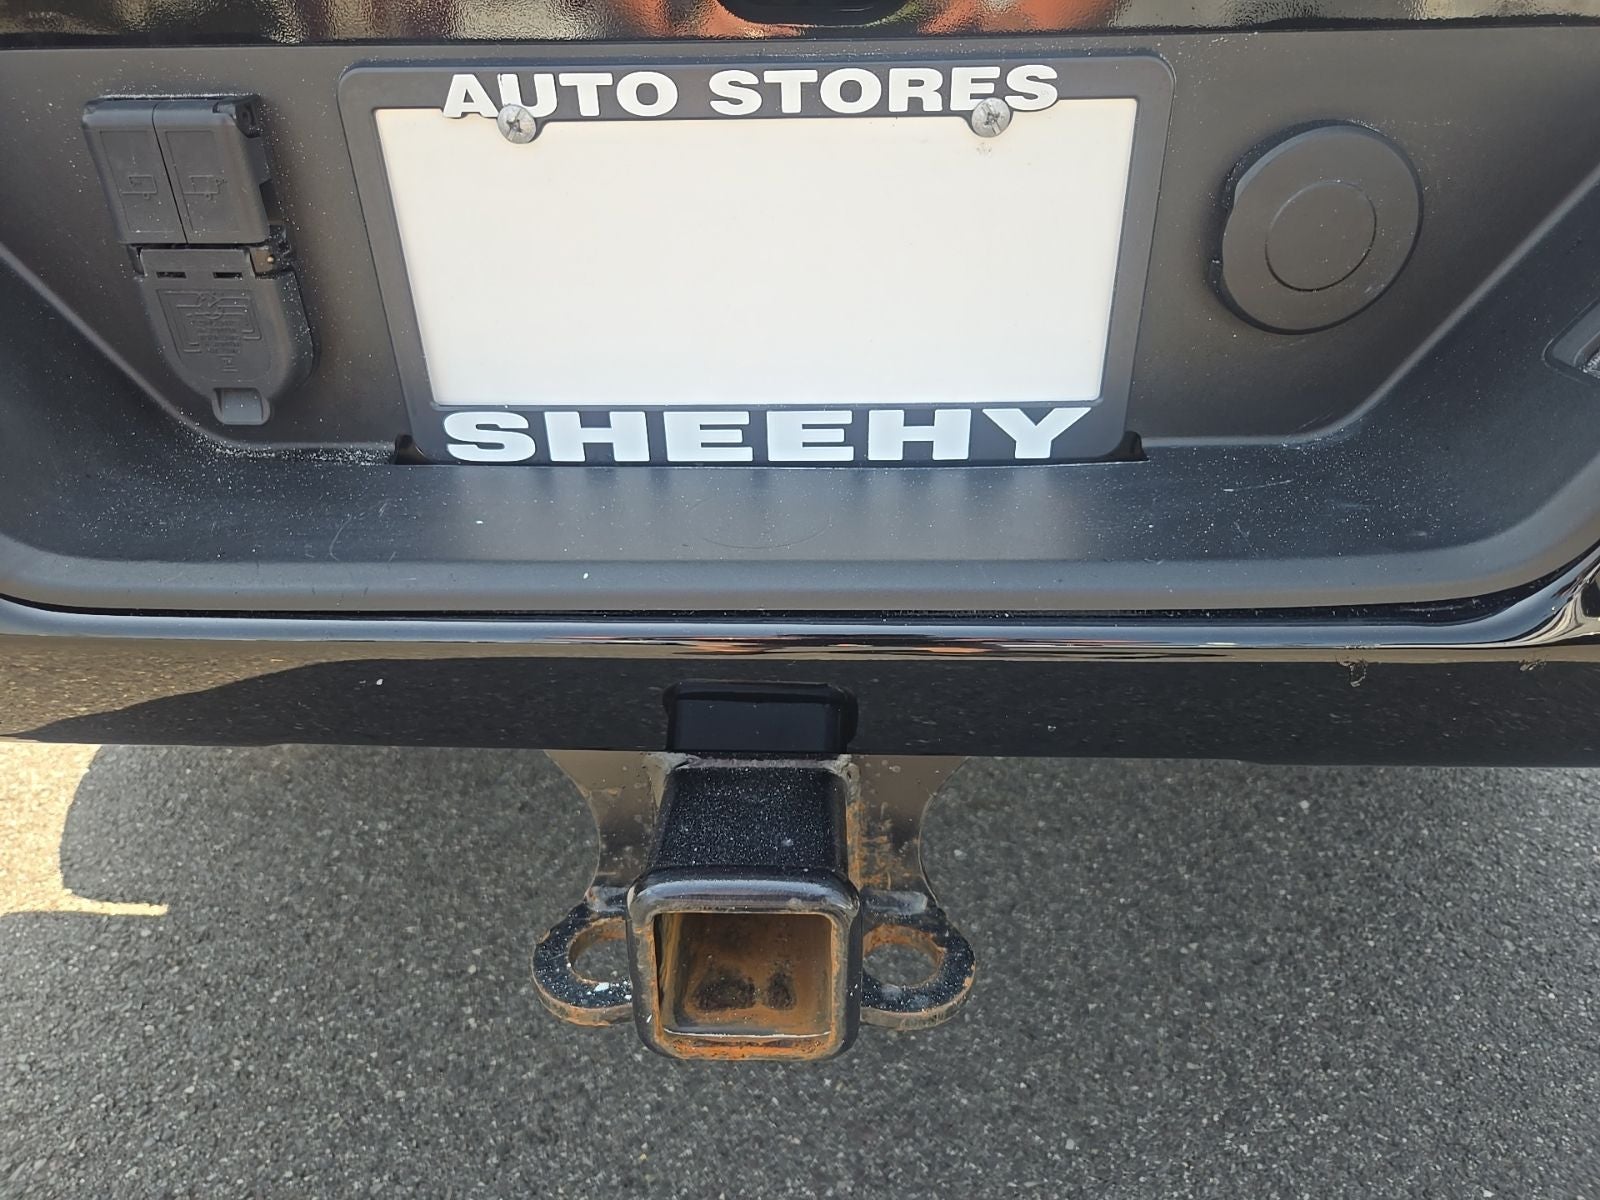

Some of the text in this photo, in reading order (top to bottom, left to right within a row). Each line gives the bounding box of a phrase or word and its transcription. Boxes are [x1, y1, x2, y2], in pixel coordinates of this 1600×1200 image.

[442, 64, 1058, 118] AUTO STORES
[443, 407, 1092, 463] SHEEHY
